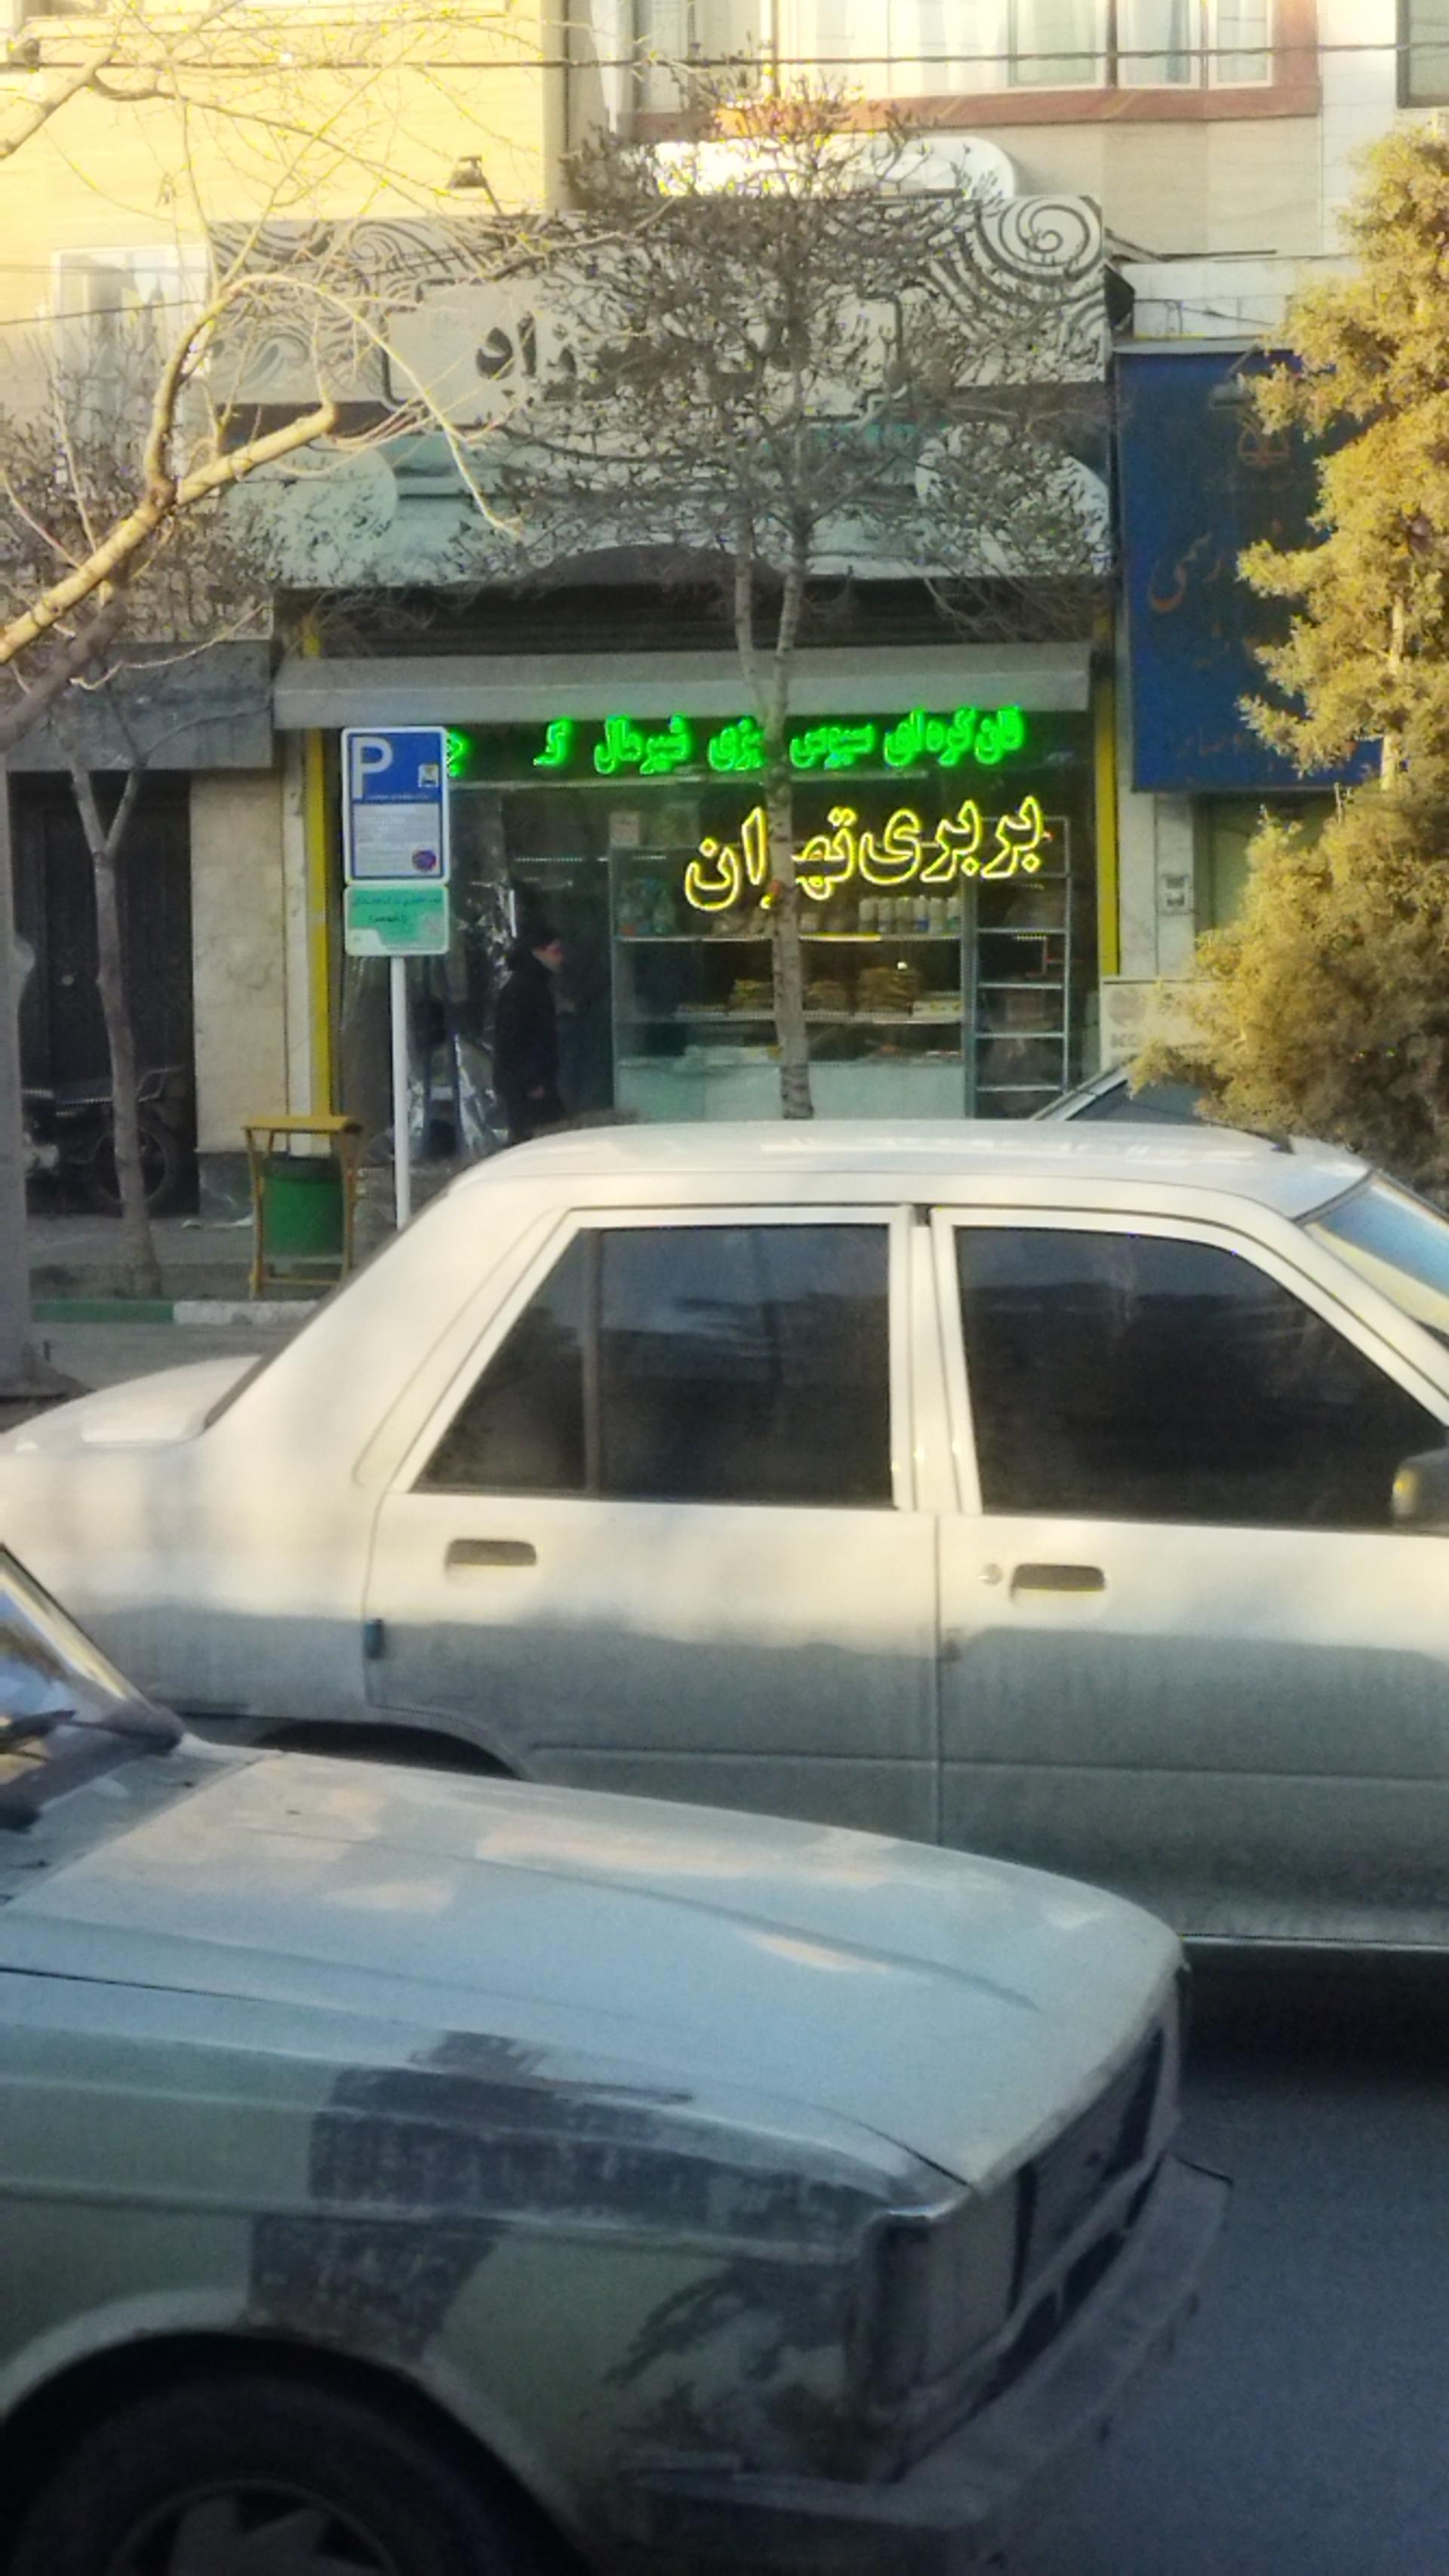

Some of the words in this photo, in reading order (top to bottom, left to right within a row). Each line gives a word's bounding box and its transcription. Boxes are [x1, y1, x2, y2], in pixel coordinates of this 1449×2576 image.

[351, 737, 393, 800] P
[594, 712, 691, 774] شیرمال
[684, 805, 857, 912] تهان
[859, 796, 1041, 885] بربری
